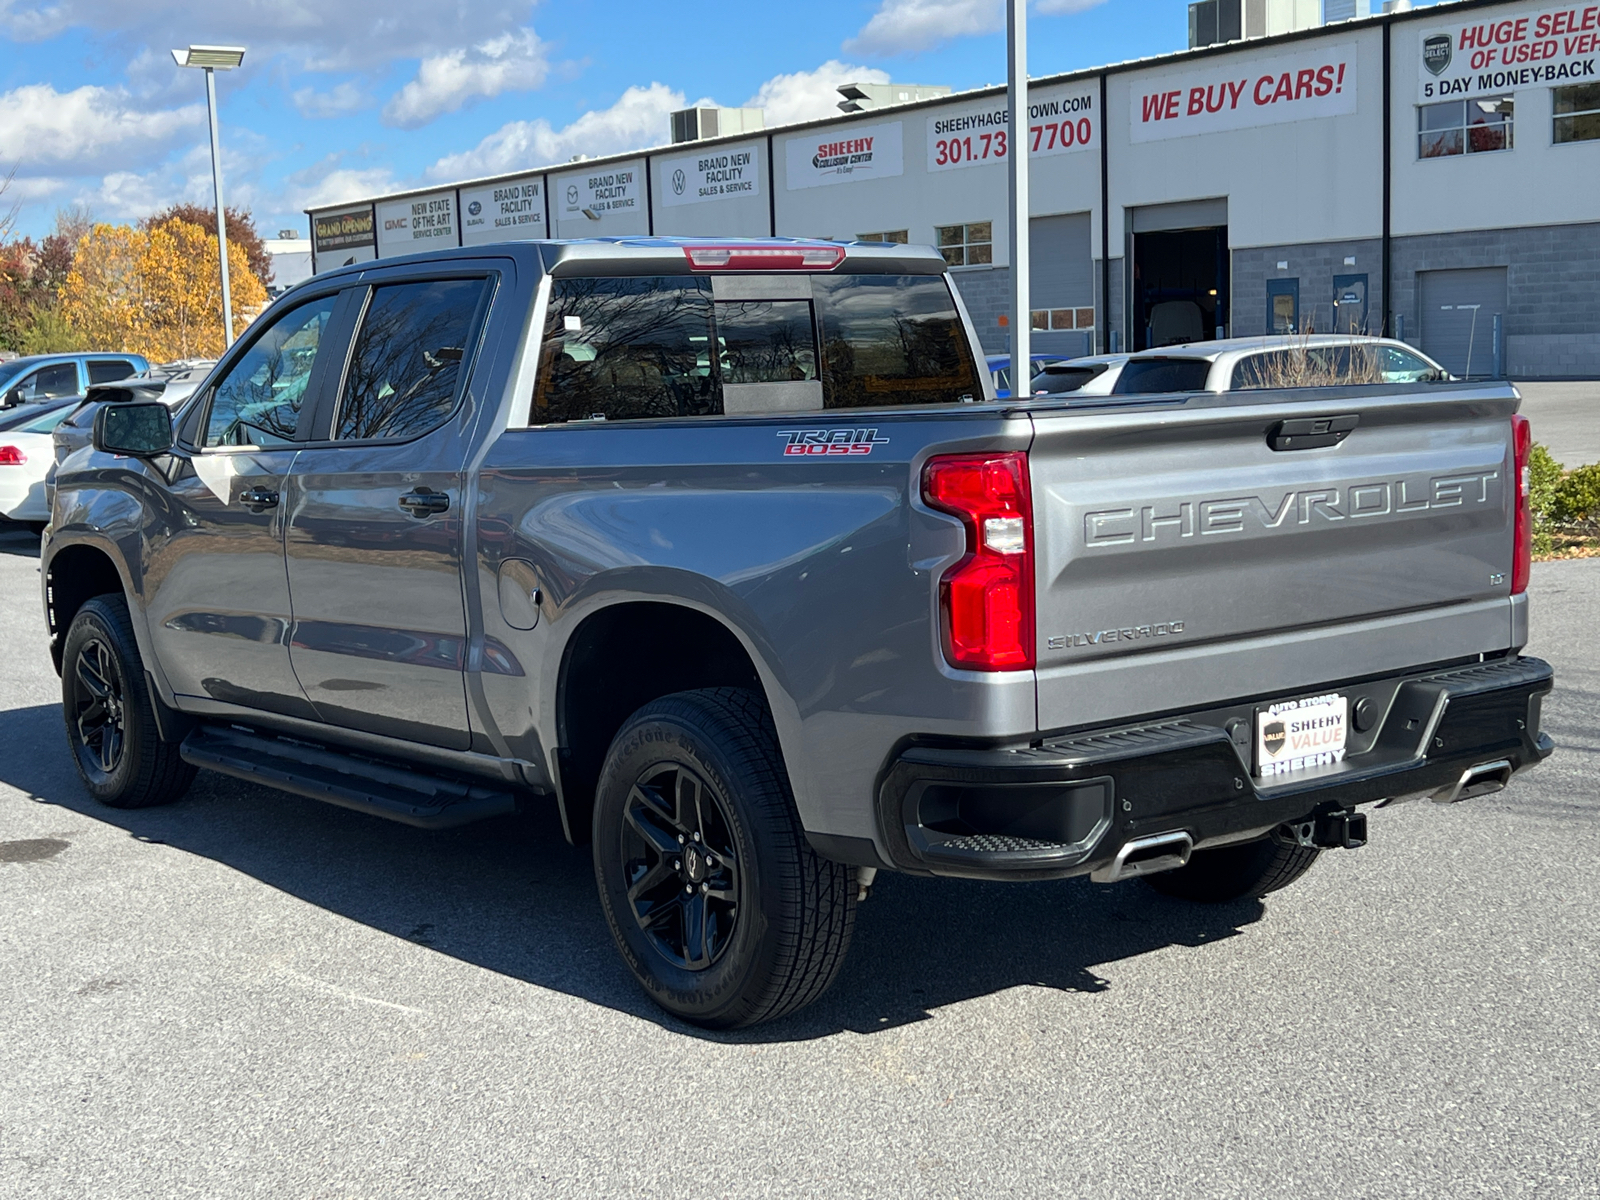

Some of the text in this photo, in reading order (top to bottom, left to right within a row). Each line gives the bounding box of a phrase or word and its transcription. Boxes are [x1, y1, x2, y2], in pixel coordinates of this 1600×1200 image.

[1459, 7, 1600, 50] HUGE SELE
[1425, 48, 1449, 58] SELECT
[1470, 49, 1497, 70] OF
[1502, 39, 1558, 65] USED
[1424, 59, 1595, 97] 5 DAY MONEY-BACK
[1142, 63, 1346, 122] WE BUY CARS!
[935, 95, 1091, 134] SHEEHYHAGEOWN.COM
[818, 136, 874, 158] SHEEHY
[936, 117, 1091, 165] 301.737700
[698, 152, 750, 172] BRAND NEW
[819, 152, 873, 168] COLLISION CENTER
[588, 172, 632, 189] BRAND NEW
[706, 167, 743, 184] FACILITY
[494, 184, 538, 202] BRAND NEW
[595, 186, 626, 200] FACILITY
[698, 181, 752, 197] SALES & SERVICE
[412, 199, 450, 215] NEW STATE
[501, 199, 532, 214] FACILITY
[589, 202, 605, 210] SALES
[612, 198, 634, 209] SERVICE
[317, 217, 372, 237] GRAND OPENING
[385, 218, 407, 230] GMC
[412, 213, 451, 229] OF THE ART
[495, 213, 540, 227] SALES & SERVICE
[413, 226, 451, 239] SERVICE CENTER
[776, 428, 890, 444] TRAIL
[783, 443, 873, 456] BOSS
[1084, 470, 1498, 547] CHEVROLET
[1047, 620, 1185, 650] SILVERADO
[1268, 701, 1298, 715] AUTO
[1291, 714, 1342, 733] SHEEHY
[1263, 728, 1342, 750] VALUE VALUE
[1261, 747, 1346, 777] SHEEHY
